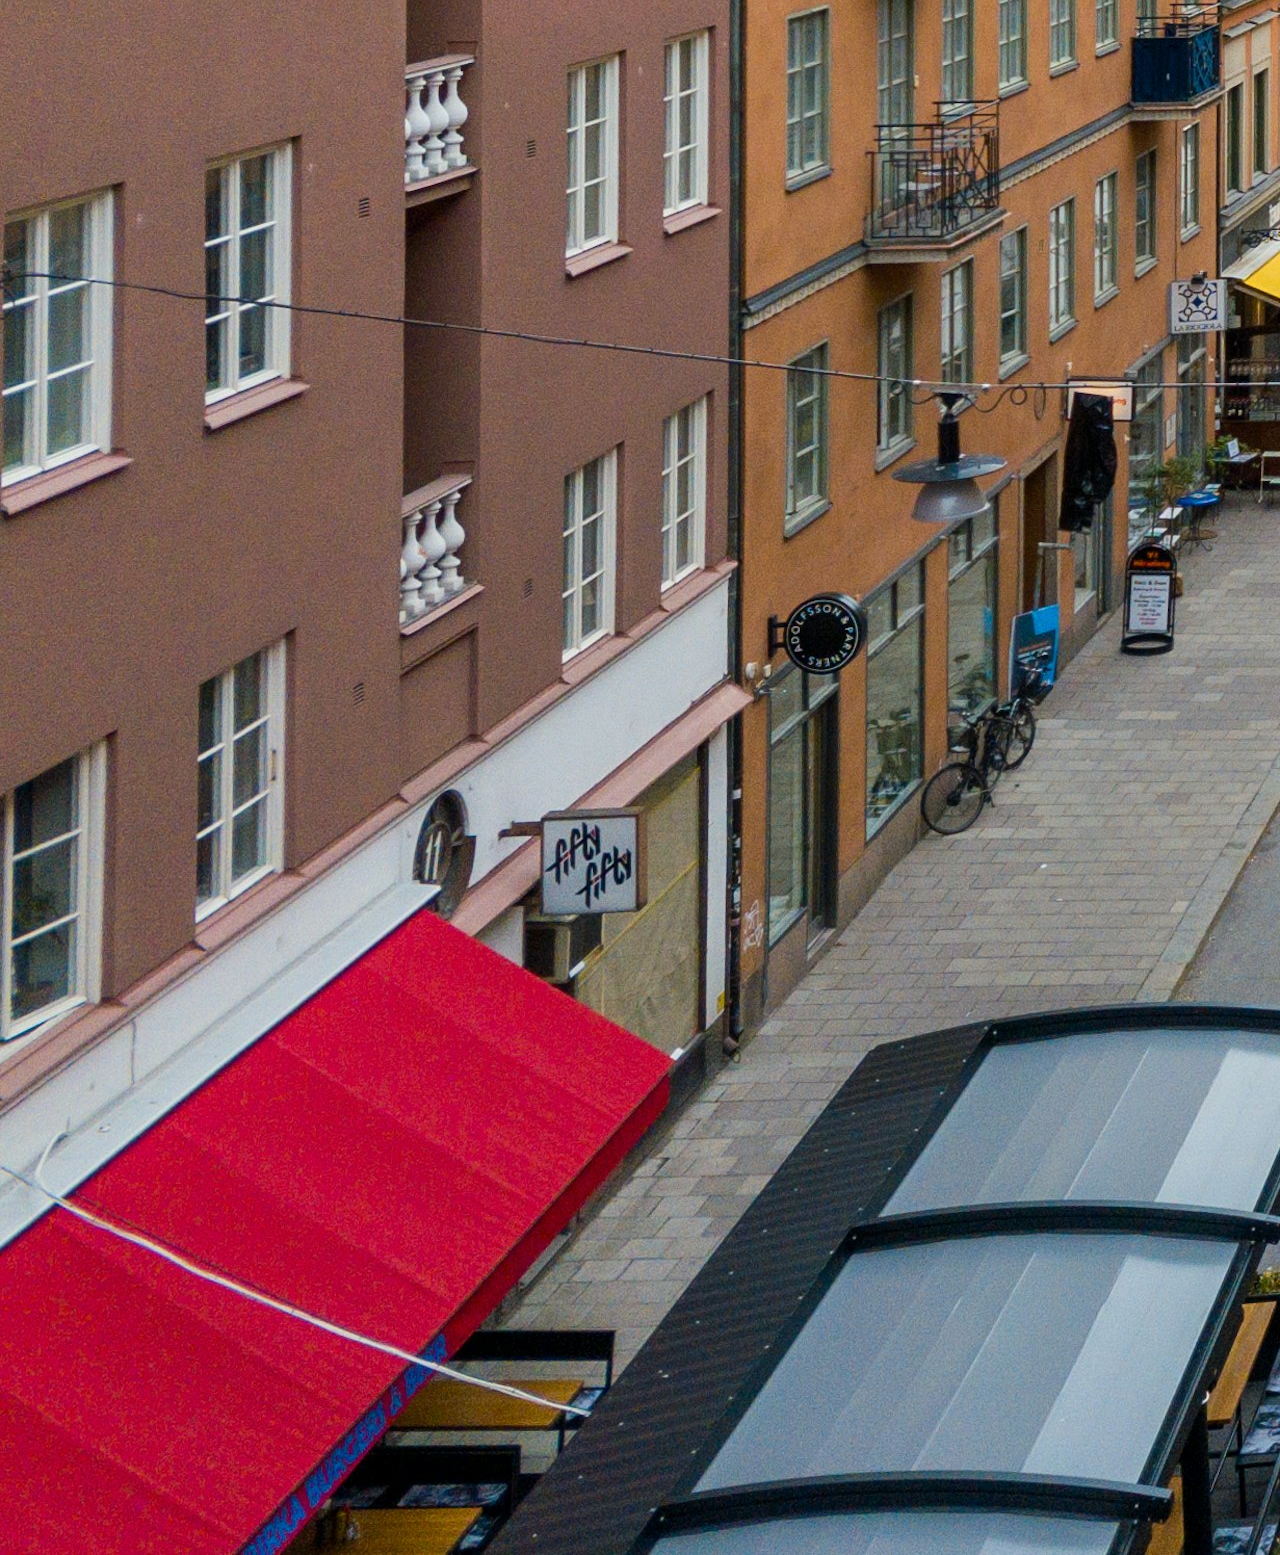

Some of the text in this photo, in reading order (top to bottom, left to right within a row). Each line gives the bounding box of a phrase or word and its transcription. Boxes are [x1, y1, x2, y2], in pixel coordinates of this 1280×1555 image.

[791, 603, 842, 653] ADOLFSSON
[808, 626, 855, 668] PARTNERS
[425, 830, 442, 880] 11
[545, 822, 600, 885] fifty
[575, 846, 632, 908] fifty
